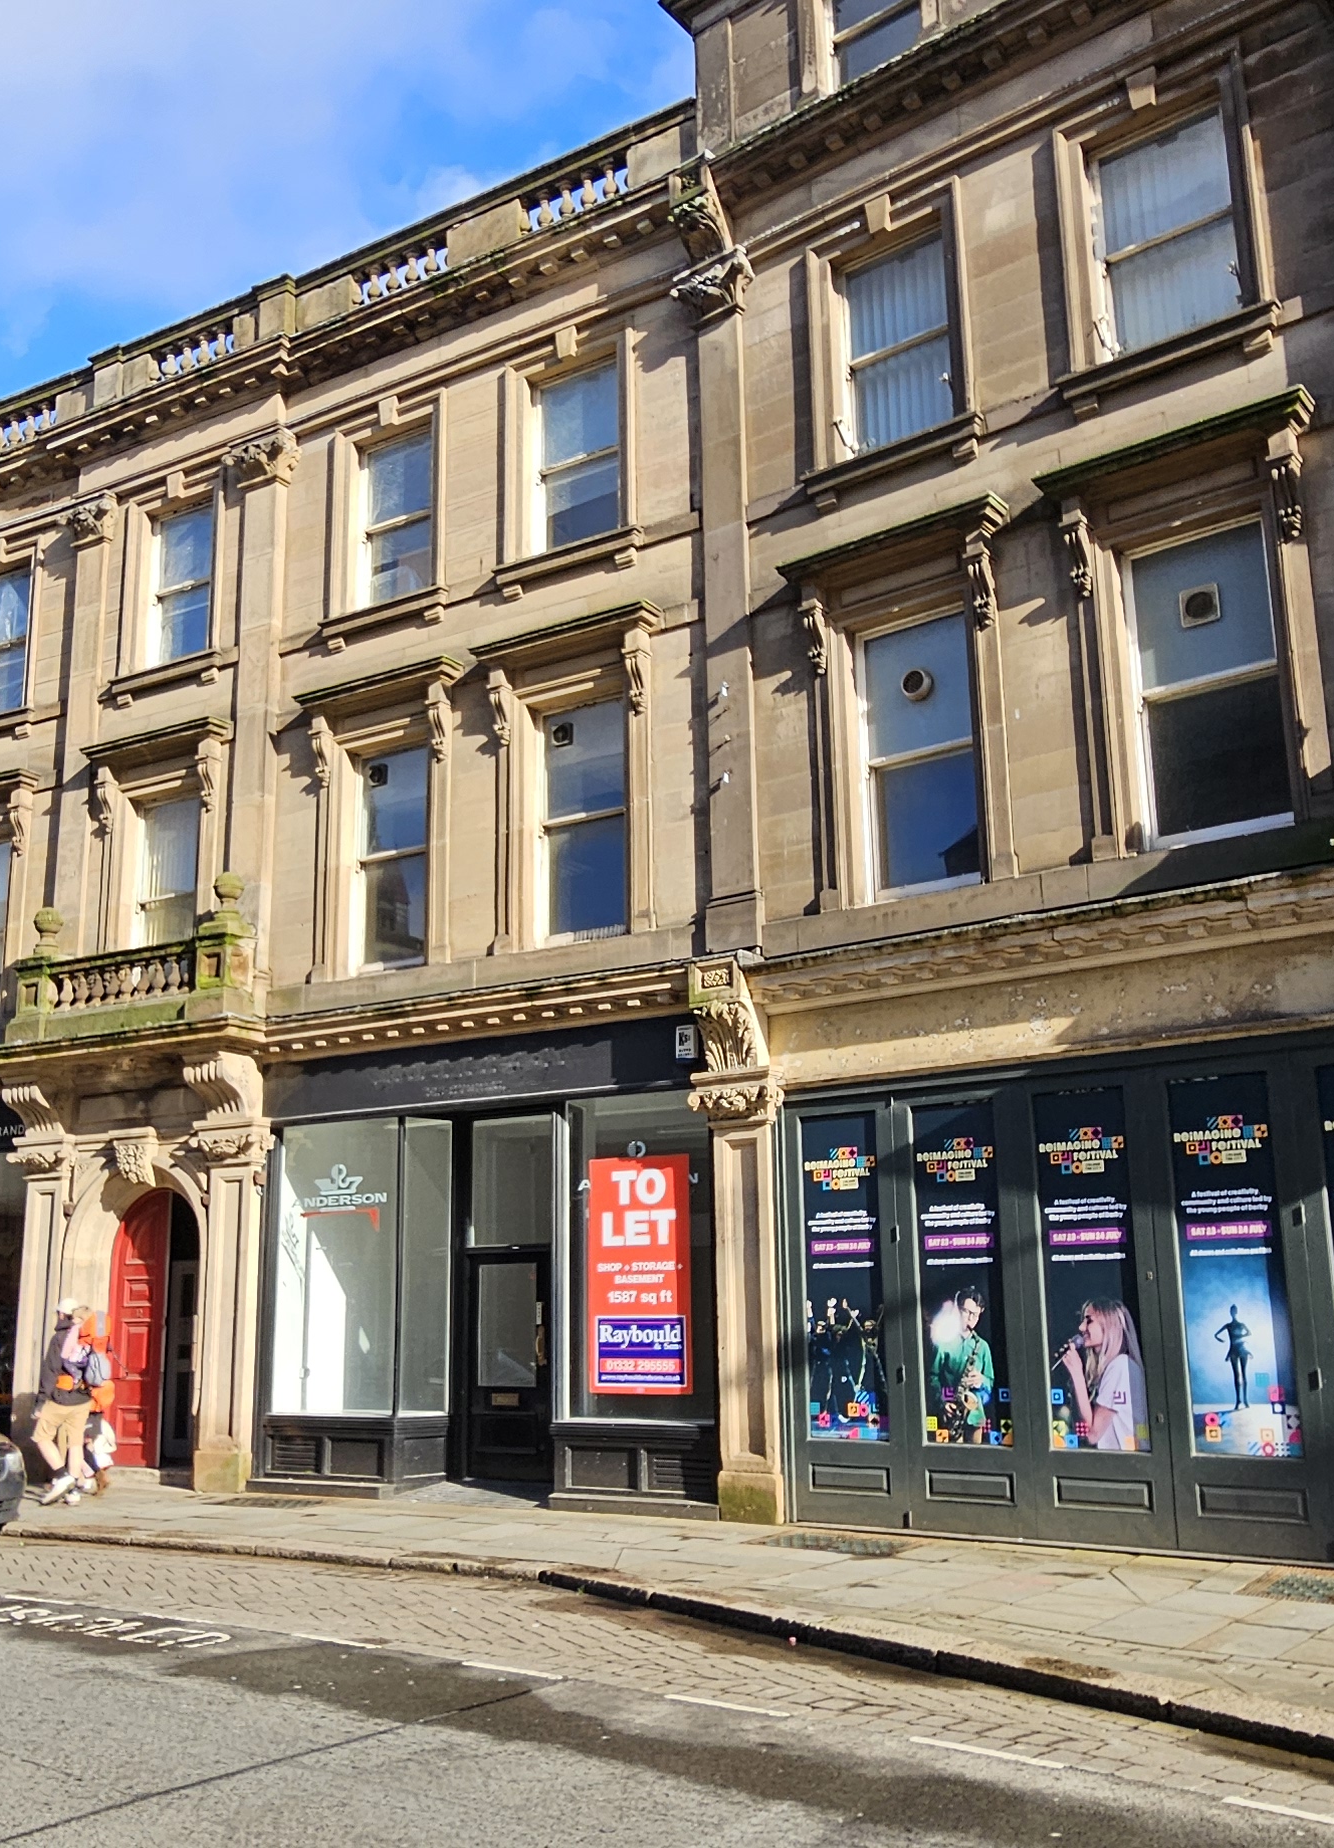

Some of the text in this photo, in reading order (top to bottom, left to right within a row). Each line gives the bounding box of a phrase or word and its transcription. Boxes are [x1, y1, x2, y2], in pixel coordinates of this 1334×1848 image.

[611, 1167, 667, 1205] TO
[292, 1192, 388, 1208] ANDERSON
[601, 1209, 677, 1247] LET
[597, 1262, 623, 1273] SHOP
[631, 1261, 676, 1272] STORAGE
[614, 1273, 665, 1284] BASEMENT
[607, 1289, 673, 1305] 1587 sq ft
[599, 1324, 682, 1349] Raybould
